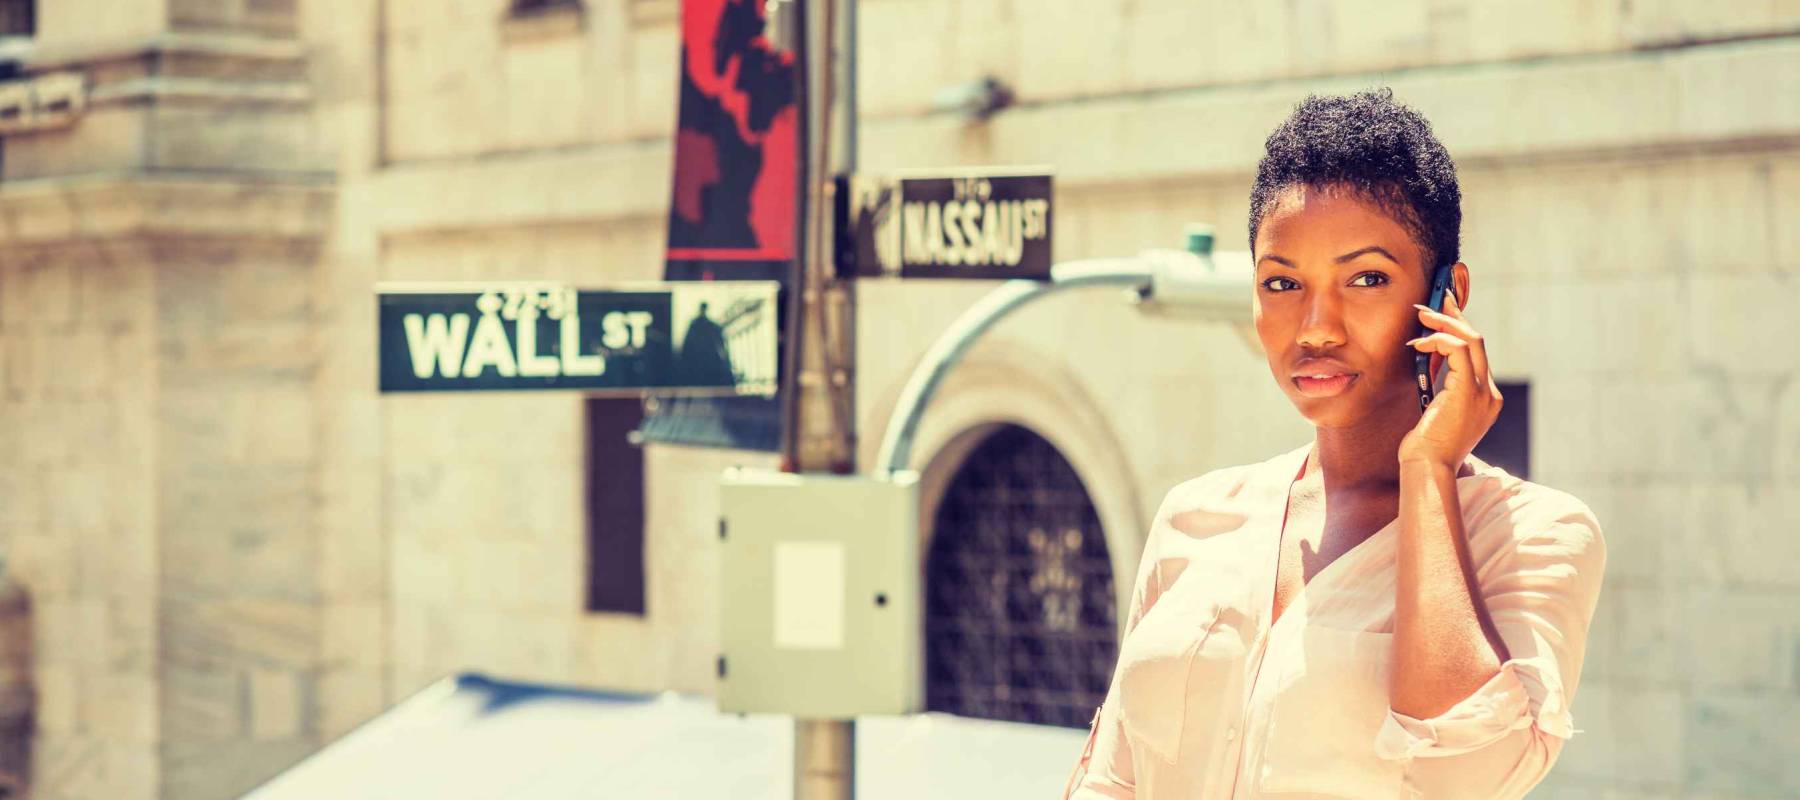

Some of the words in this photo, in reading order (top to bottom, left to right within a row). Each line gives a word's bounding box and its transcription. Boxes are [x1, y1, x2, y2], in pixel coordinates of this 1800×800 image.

[904, 201, 1023, 266] NASSAU
[1022, 199, 1048, 240] ST
[403, 313, 605, 378] WALL
[602, 311, 653, 349] ST
